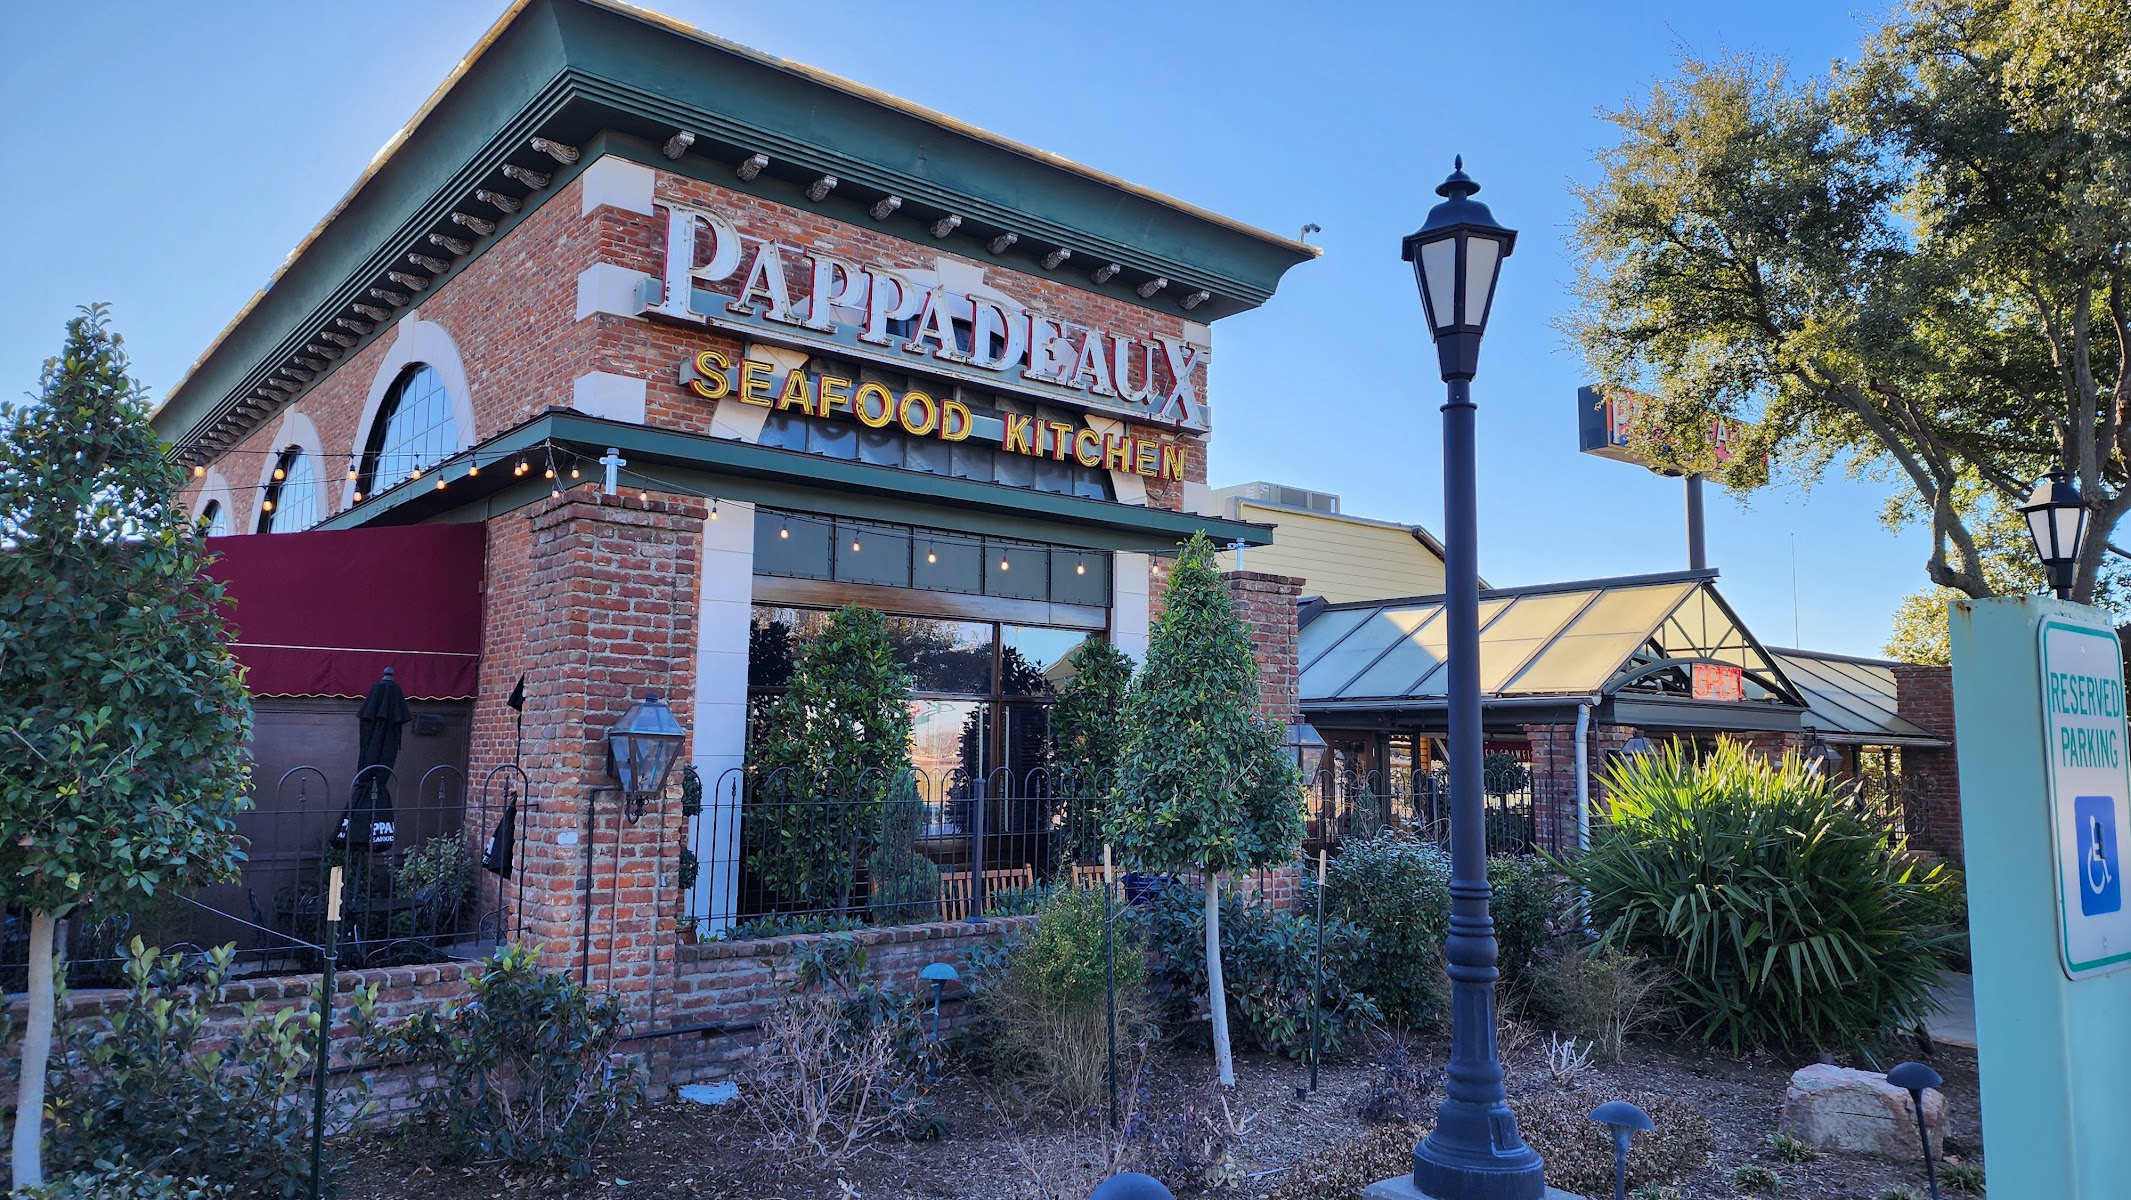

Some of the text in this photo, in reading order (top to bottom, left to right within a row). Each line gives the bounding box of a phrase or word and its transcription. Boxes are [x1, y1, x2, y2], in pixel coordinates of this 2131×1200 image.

[649, 197, 1211, 432] PAPPADEAUX
[690, 349, 1187, 483] SEAFOOD KITCHEN
[1695, 665, 1743, 699] OPEN
[2050, 672, 2120, 717] RESERVED
[2061, 727, 2118, 769] PARKING
